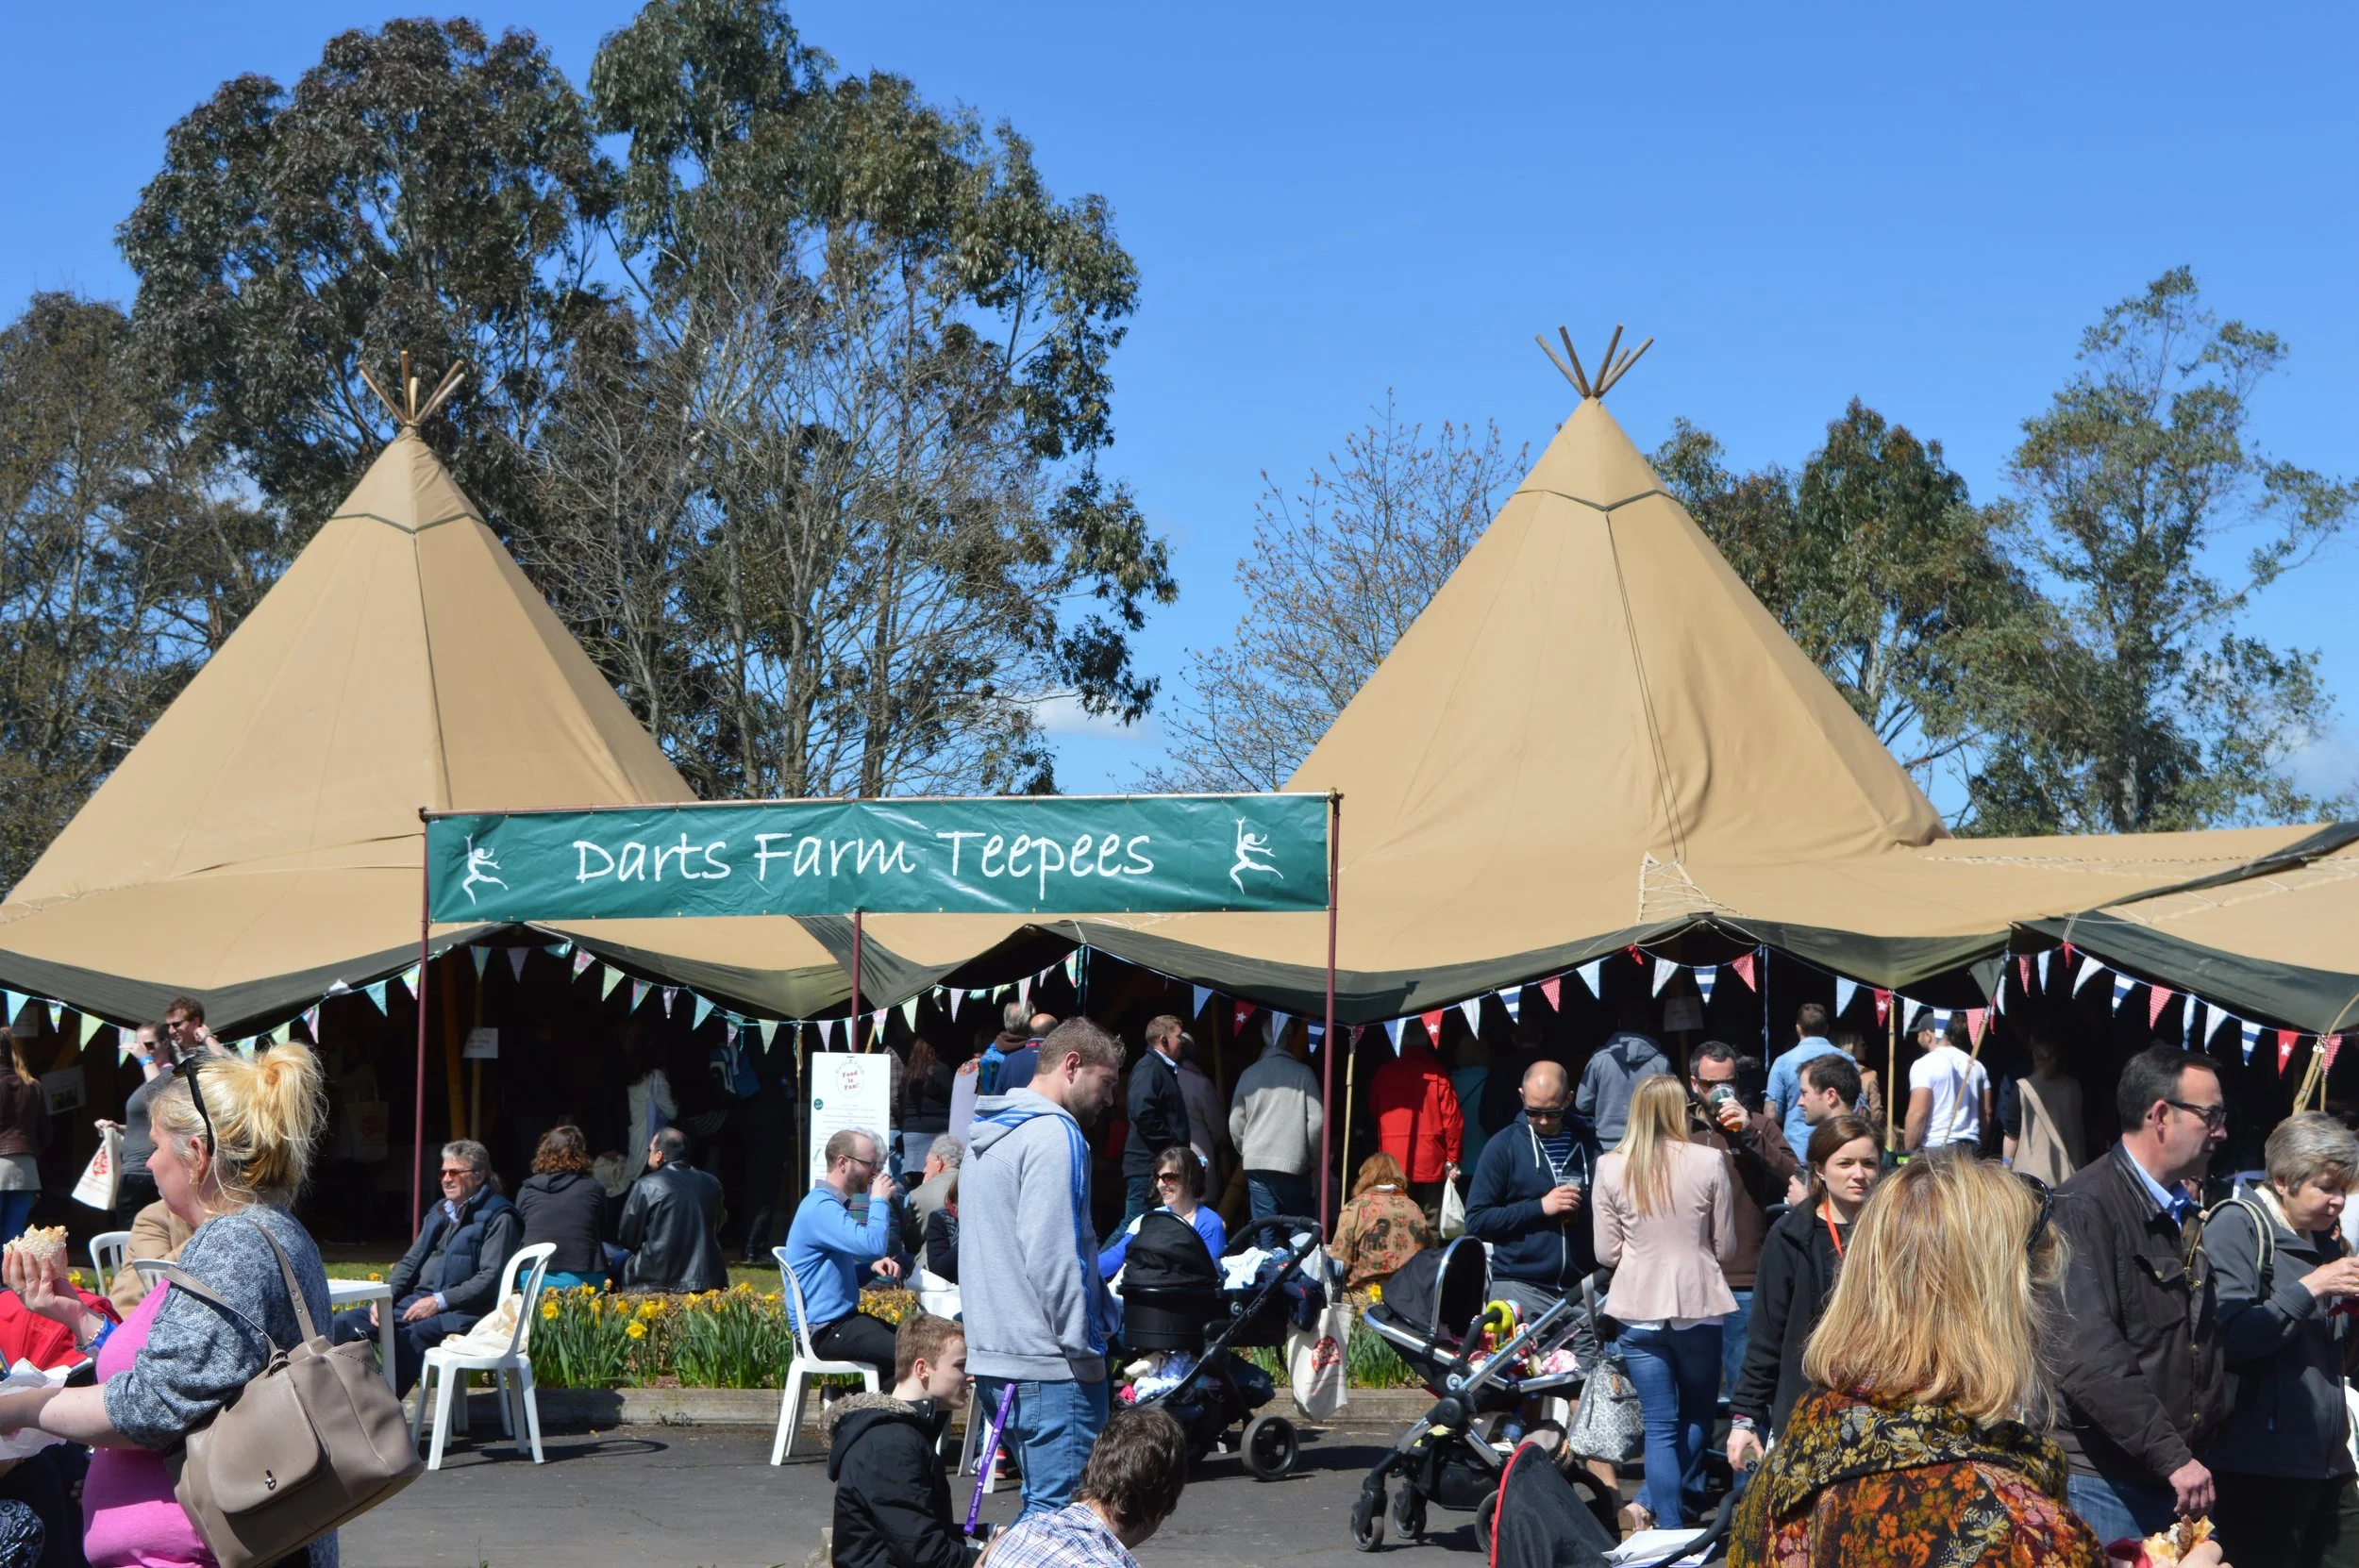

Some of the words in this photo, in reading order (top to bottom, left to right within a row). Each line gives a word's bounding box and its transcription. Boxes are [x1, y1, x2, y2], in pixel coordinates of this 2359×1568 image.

[573, 832, 731, 883] Darts
[754, 832, 916, 881] Farm
[936, 830, 1154, 900] Teepees
